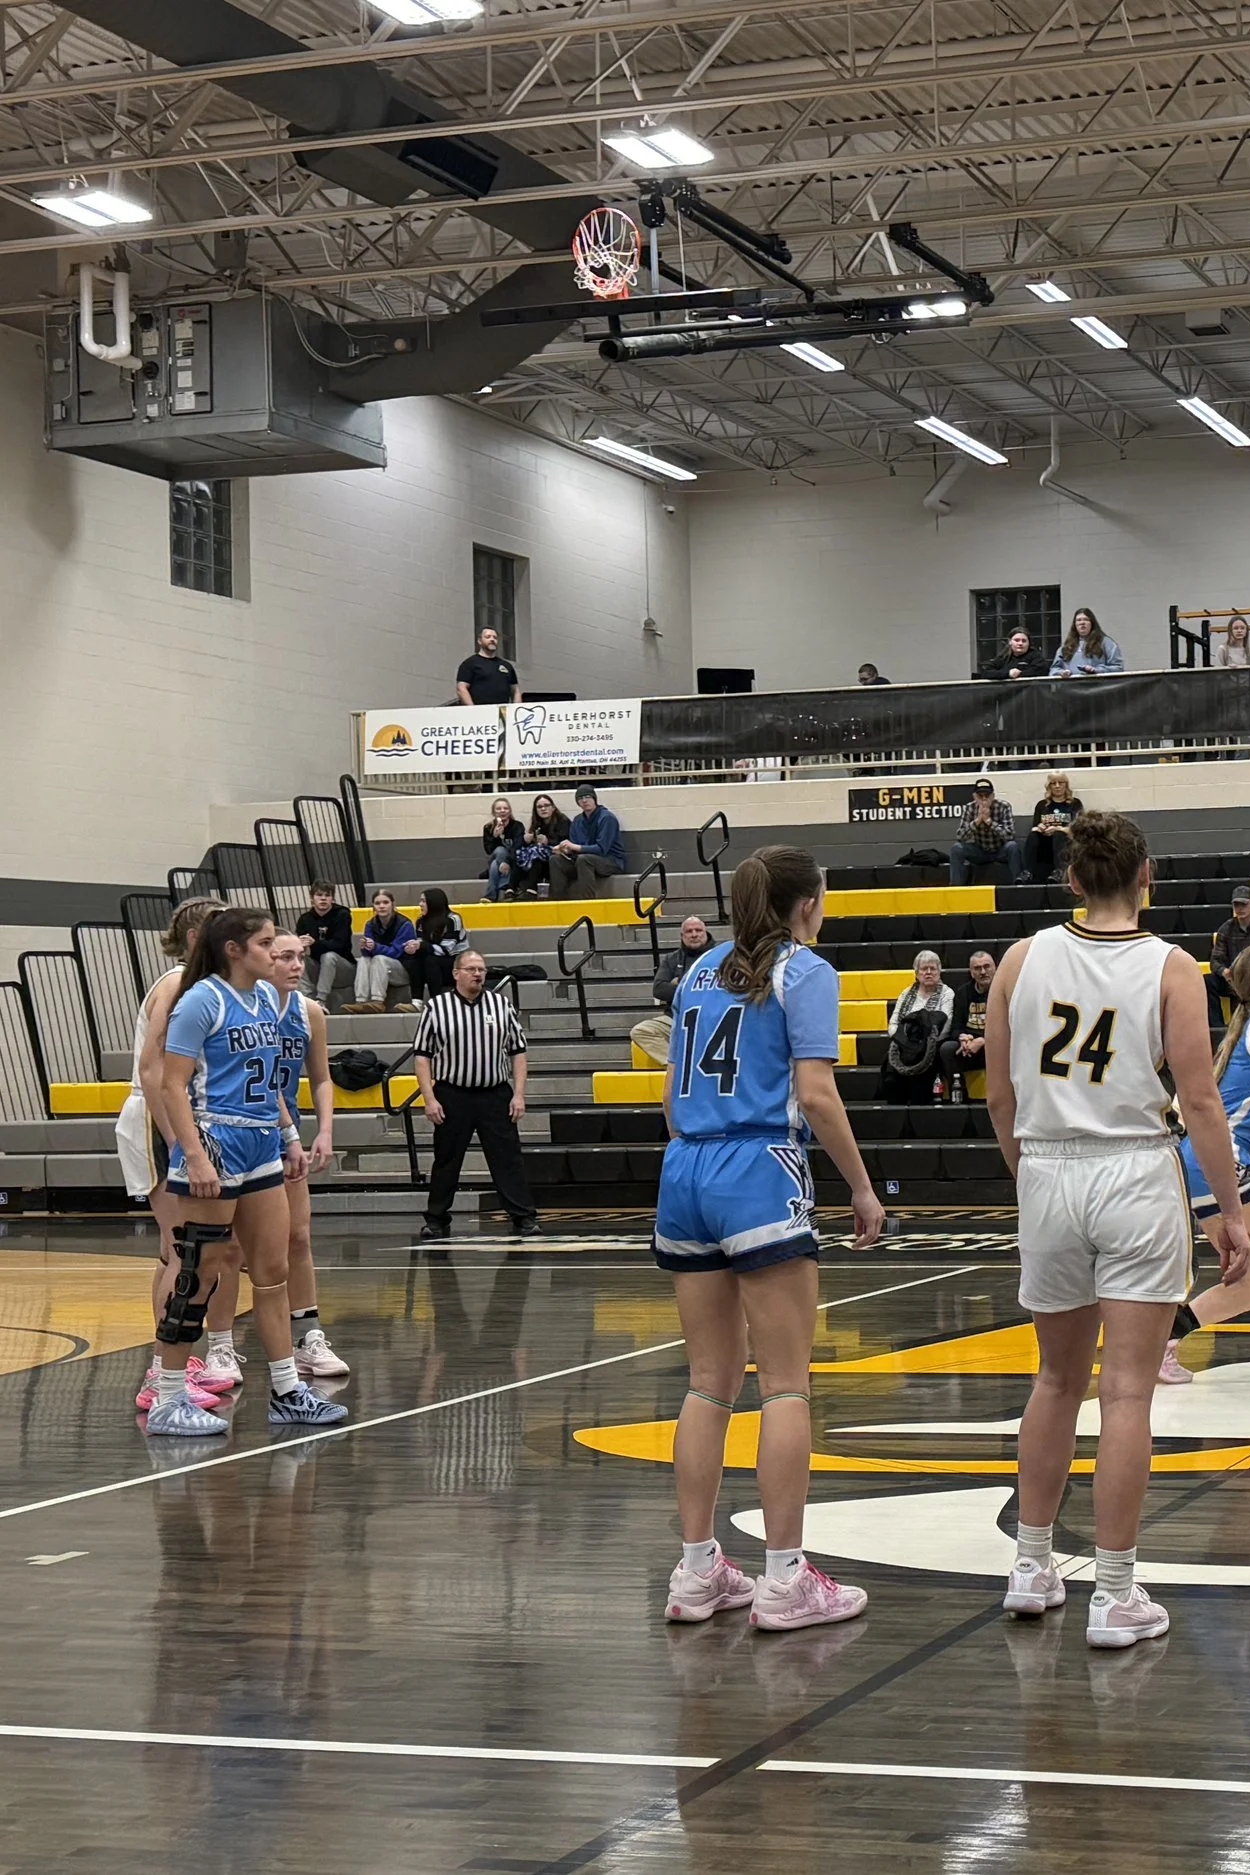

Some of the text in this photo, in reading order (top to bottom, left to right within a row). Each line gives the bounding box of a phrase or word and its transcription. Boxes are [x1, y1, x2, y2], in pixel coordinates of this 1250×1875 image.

[549, 710, 632, 722] ELLERHORST
[421, 725, 498, 737] GREAT LAKES
[568, 722, 611, 730] DENTAL
[421, 738, 496, 757] CHEESE
[878, 786, 944, 806] G-MEN
[852, 807, 912, 822] STUDENT
[226, 1021, 280, 1054] ROVER
[1039, 999, 1118, 1086] 24
[679, 1004, 745, 1098] 14
